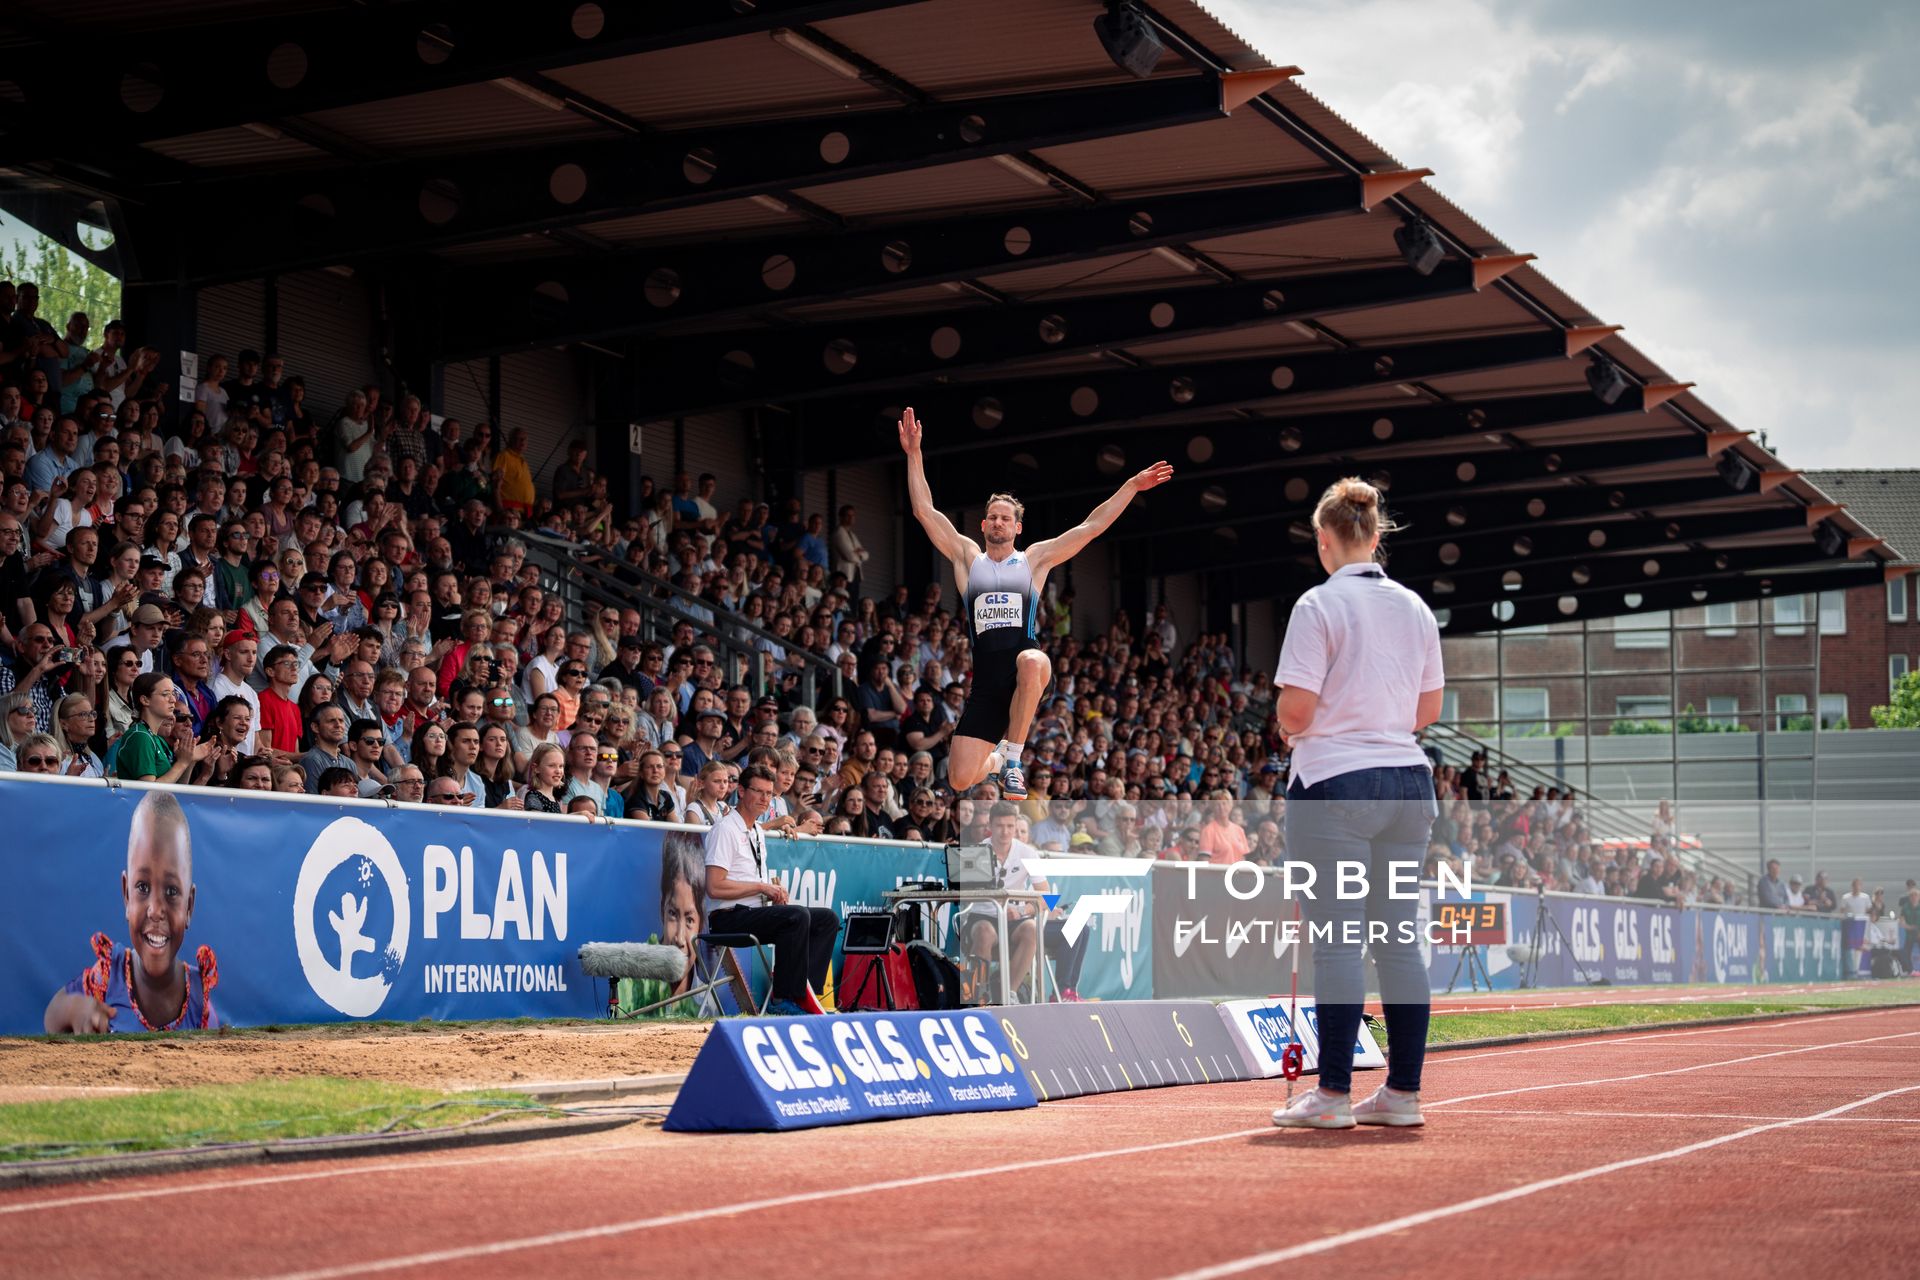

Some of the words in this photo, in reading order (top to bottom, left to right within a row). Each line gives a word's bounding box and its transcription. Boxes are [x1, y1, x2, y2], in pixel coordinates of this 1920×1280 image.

[632, 426, 638, 447] 2
[976, 607, 1020, 620] KAZMIREK
[423, 844, 568, 942] PLAN
[1727, 923, 1748, 957] PLAN
[424, 964, 567, 993] INTERNATIONAL
[1002, 1018, 1029, 1060] 8
[1090, 1014, 1114, 1053] 7
[1172, 1011, 1194, 1048] 6
[776, 1100, 812, 1117] Parcels
[812, 1099, 823, 1114] to
[820, 1096, 851, 1115] People
[864, 1091, 896, 1108] Parcels
[902, 1089, 934, 1108] People
[950, 1085, 980, 1102] Parcels
[980, 1086, 991, 1099] to
[989, 1082, 1018, 1101] People
